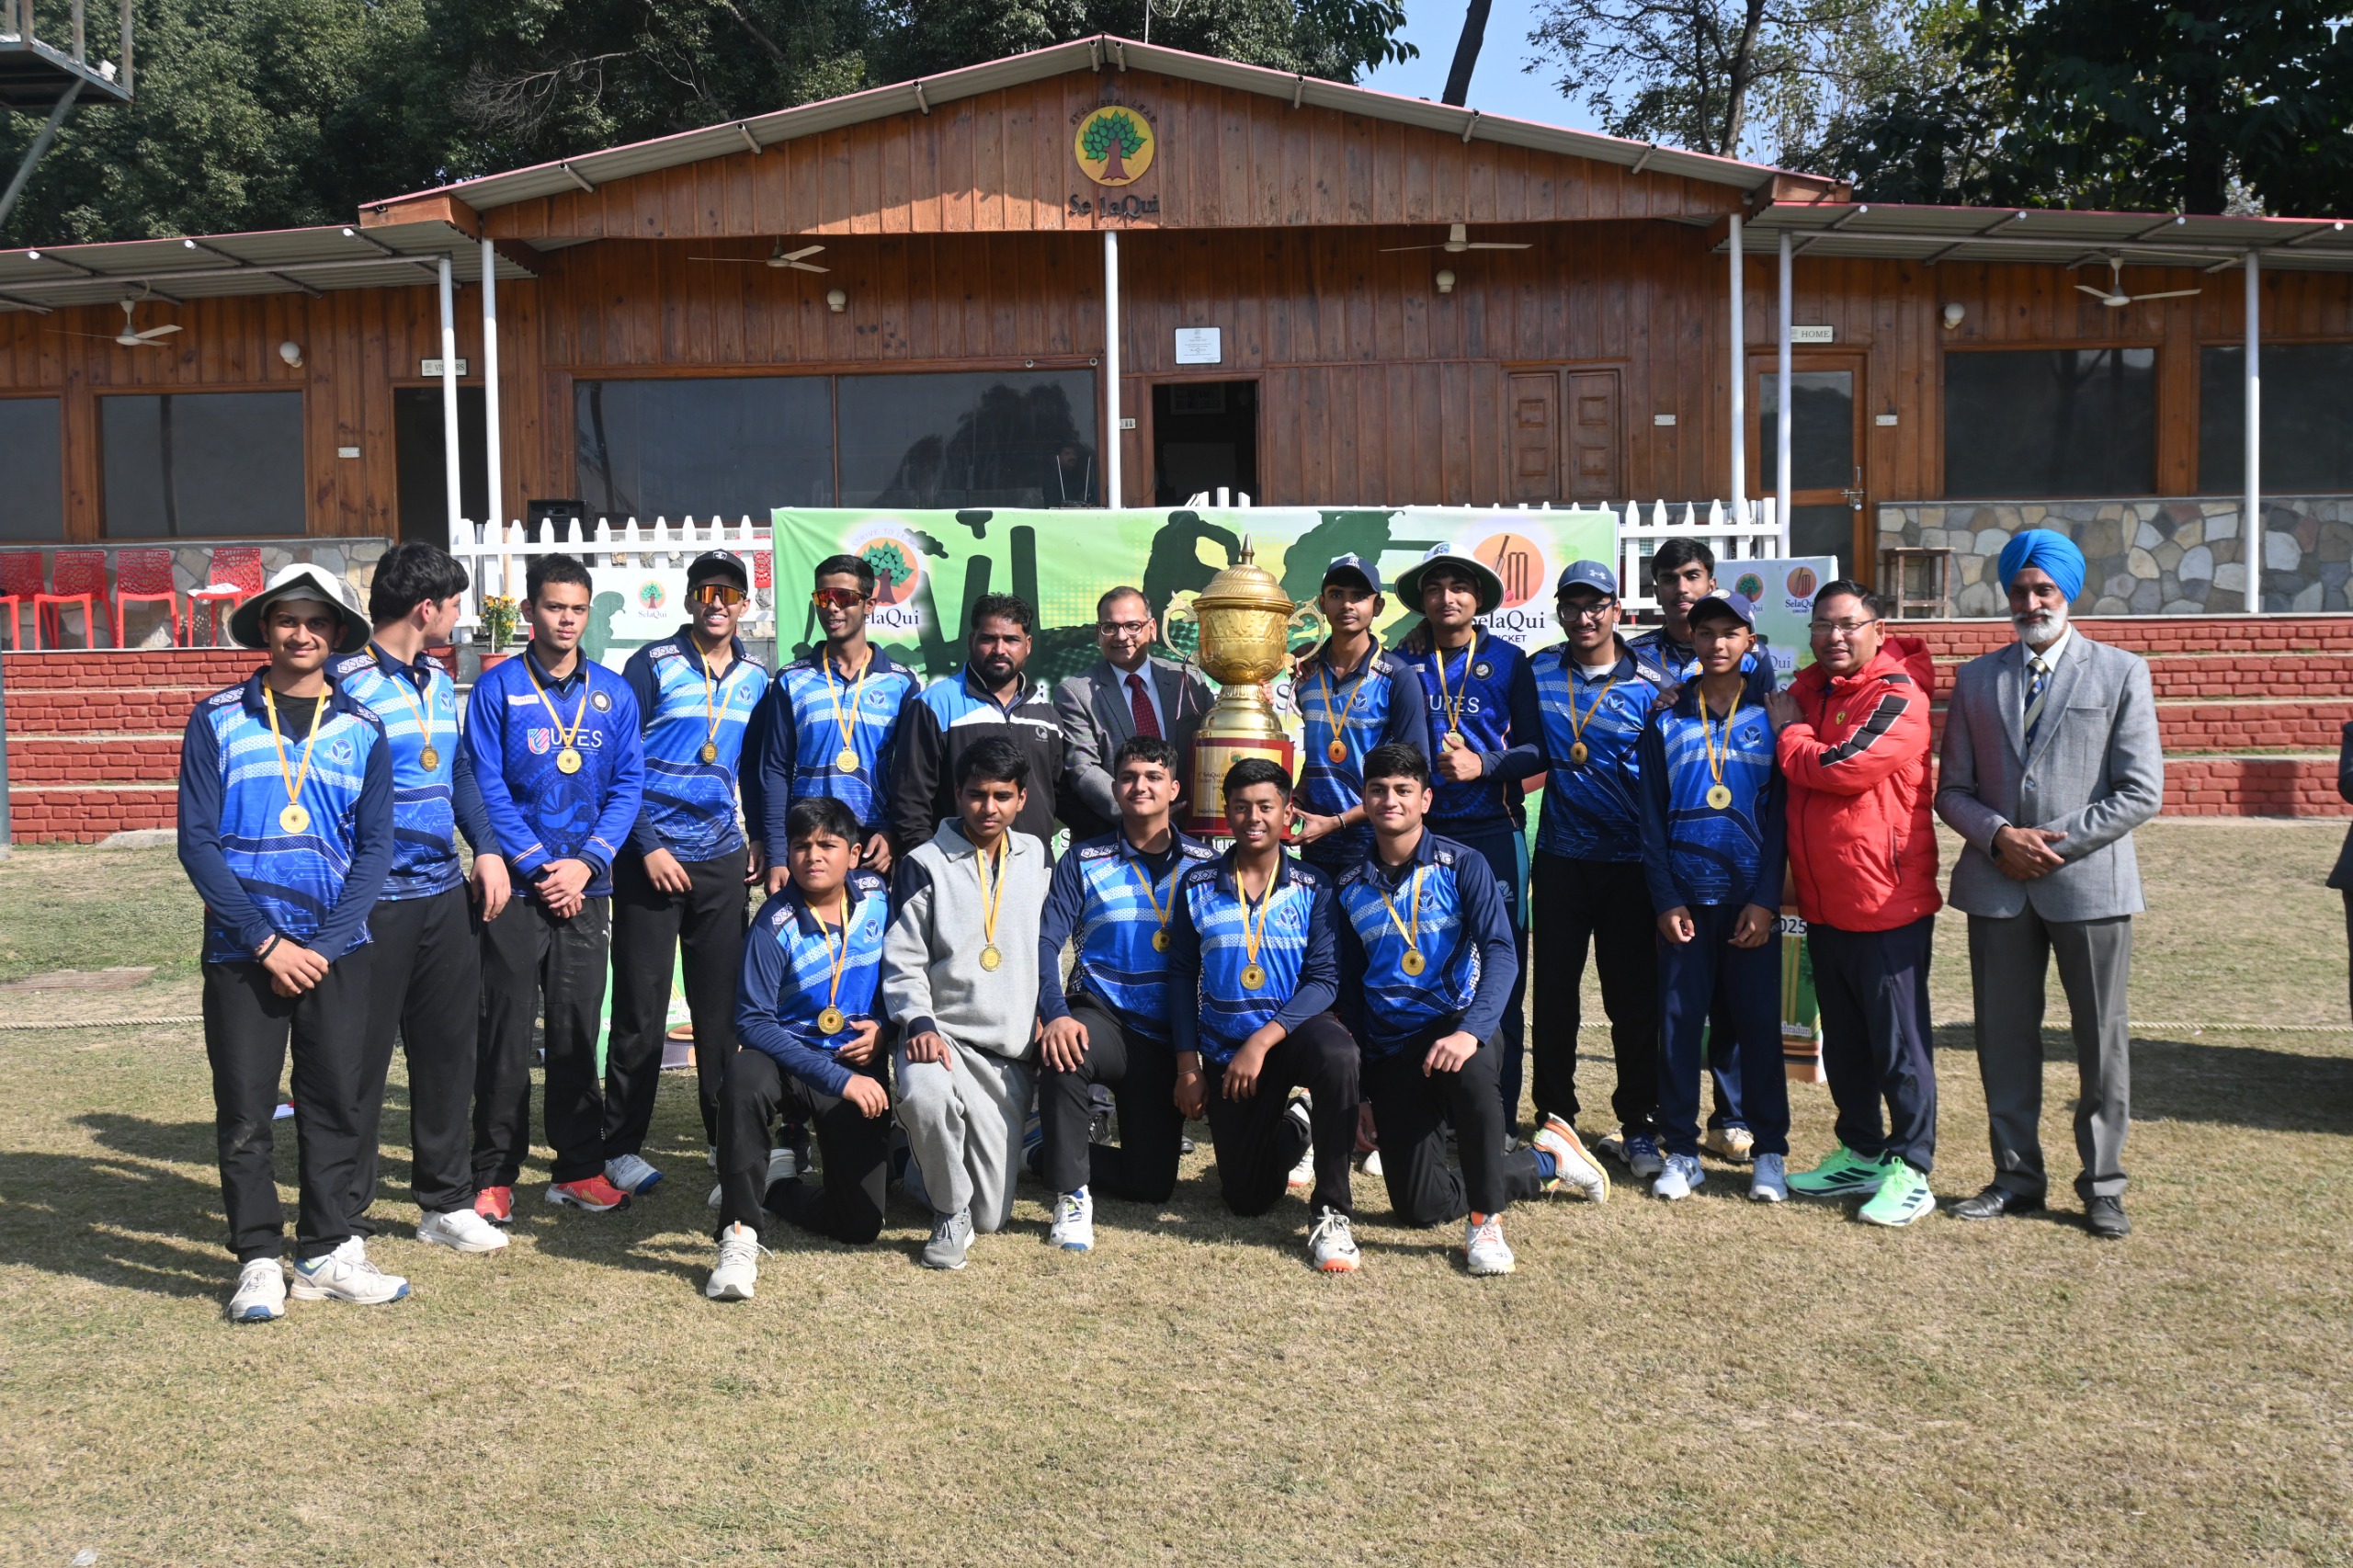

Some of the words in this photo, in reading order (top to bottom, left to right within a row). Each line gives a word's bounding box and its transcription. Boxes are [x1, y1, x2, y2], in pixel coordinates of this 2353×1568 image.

[1802, 330, 1830, 338] HOME
[1785, 599, 1814, 608] SelaQu
[638, 610, 667, 619] SelaQui
[864, 608, 919, 628] elaQui
[1472, 609, 1546, 632] elaQui
[1779, 917, 1808, 935] 025
[1781, 1023, 1811, 1036] hradun
